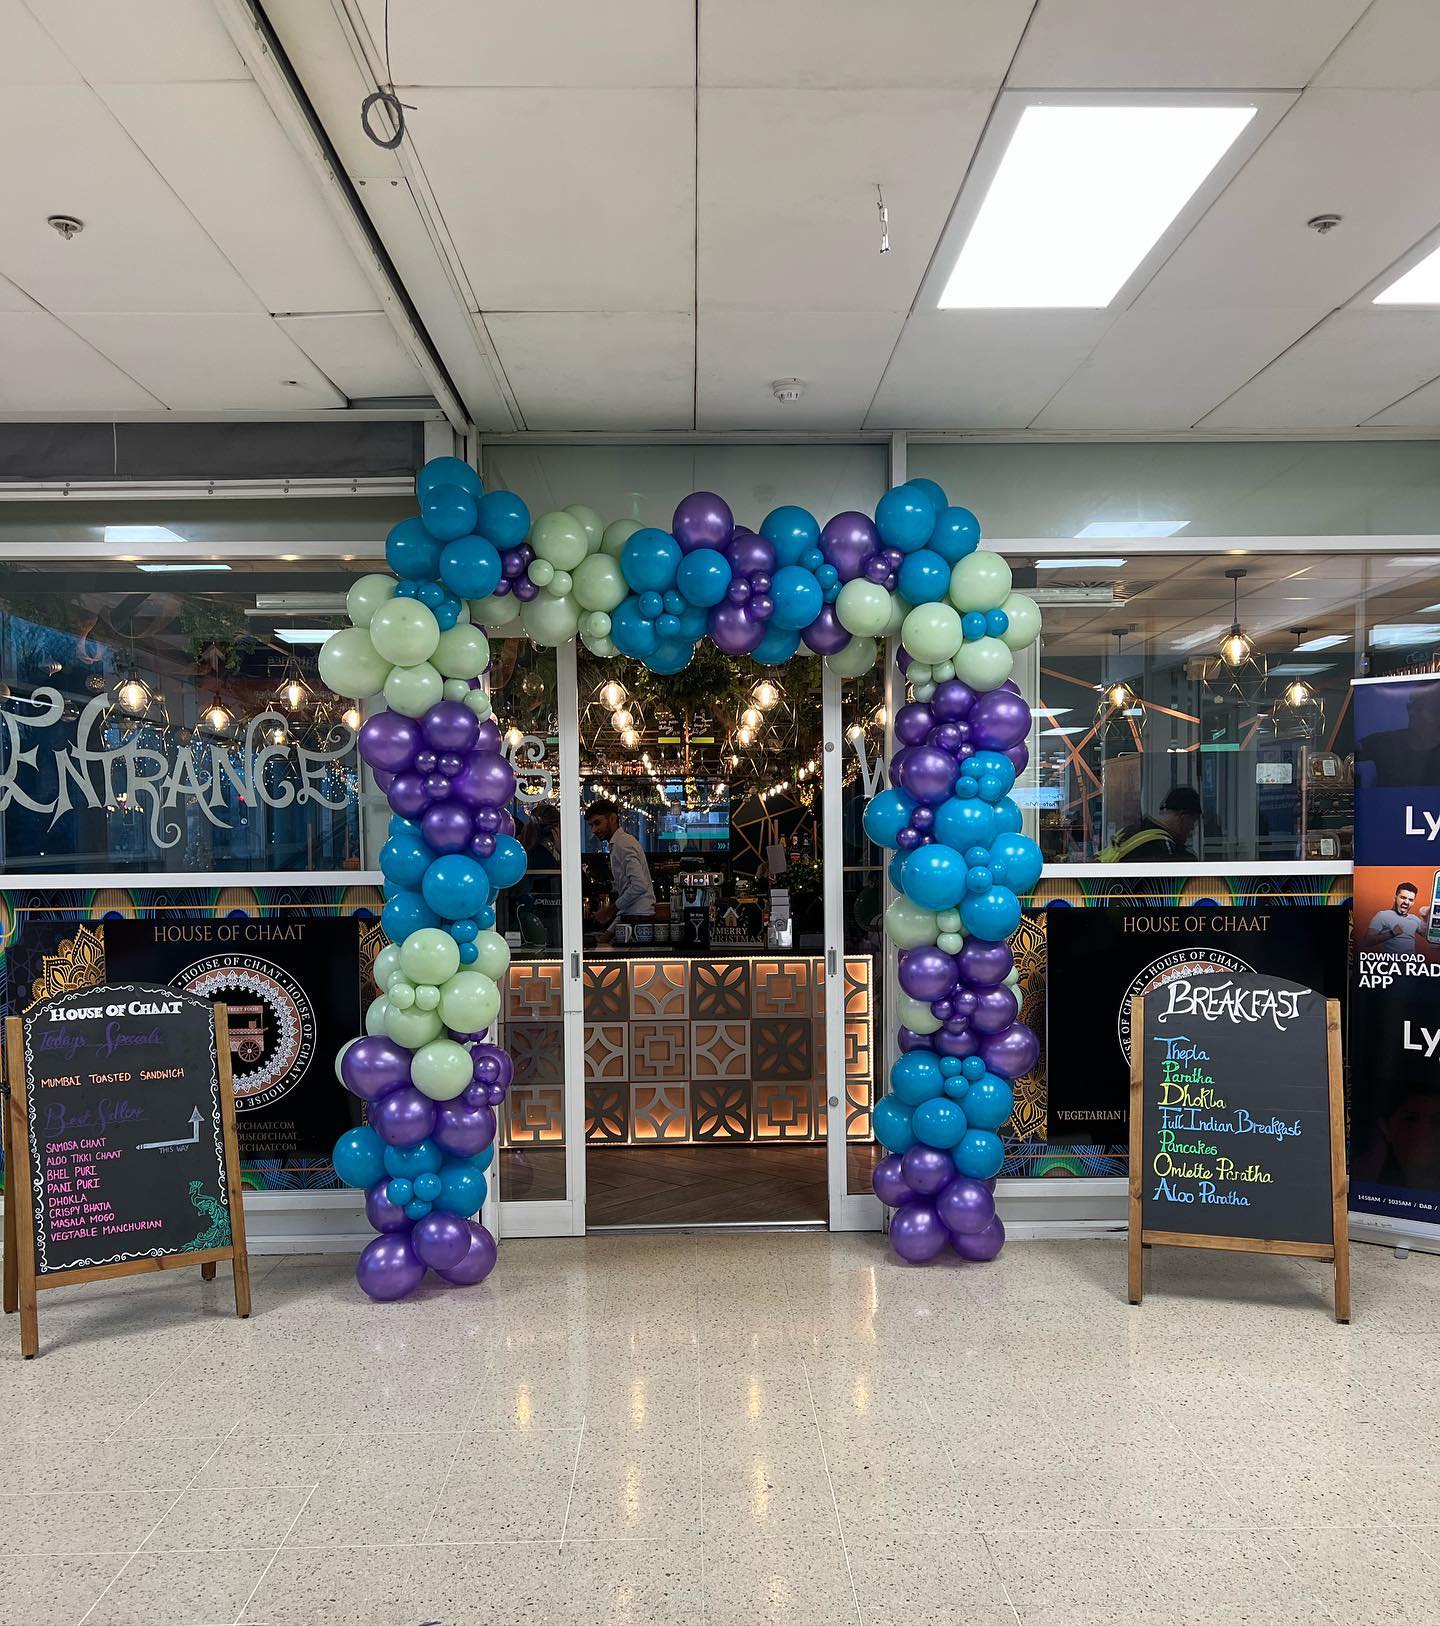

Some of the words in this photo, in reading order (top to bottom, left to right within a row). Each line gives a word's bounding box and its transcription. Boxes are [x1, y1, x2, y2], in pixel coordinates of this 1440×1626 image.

[715, 927, 748, 935] MERRY
[1123, 916, 1179, 932] HOUSE
[1184, 916, 1206, 932] OF
[1211, 915, 1270, 932] CHAAT
[154, 925, 213, 942] HOUSE
[217, 925, 240, 941] OF
[245, 924, 306, 941] CHAAT
[1148, 952, 1187, 976] HOUSE
[1190, 951, 1205, 960] OF
[1209, 952, 1247, 973] CHAAT
[1359, 952, 1425, 963] DOWNLOAD
[182, 958, 220, 982] HOUSE
[223, 957, 240, 965] OF
[244, 958, 283, 981] CHAAT
[1359, 961, 1402, 976] LYCA
[1405, 963, 1440, 979] RAD
[1358, 974, 1394, 989] APP
[286, 983, 311, 1021] HOUSE
[1158, 980, 1313, 1032] BREAKFAST
[49, 1007, 103, 1022] HOUSE
[106, 1004, 127, 1017] OF
[128, 1001, 183, 1016] CHAAT
[303, 1023, 312, 1040] OF
[1121, 1018, 1130, 1034] OF
[289, 1042, 311, 1081] CHAAT
[1153, 1036, 1210, 1069] Thepla
[41, 1075, 82, 1089] MUMBAI
[88, 1072, 131, 1084] TOASTED
[140, 1068, 185, 1081] SANDWICH
[1161, 1060, 1215, 1084] Paratha
[248, 1083, 286, 1107] HOUSE
[1057, 1110, 1121, 1120] VEGETARIAN
[1158, 1106, 1184, 1130] Full
[1183, 1107, 1235, 1133] Indian
[1233, 1109, 1302, 1142] Breakfast
[46, 1140, 79, 1153] SAMOSA
[80, 1137, 107, 1149] CHAAT
[158, 1146, 173, 1155] THIS
[175, 1144, 191, 1153] WAY
[1157, 1129, 1218, 1156] Pancakes
[46, 1156, 67, 1167] ALOO
[70, 1153, 92, 1163] TIKKI
[95, 1149, 123, 1160] CHAAT
[1153, 1152, 1213, 1180] Omlette
[47, 1168, 70, 1181] BHEL
[74, 1165, 98, 1177] PURI
[47, 1181, 73, 1194] PANI
[76, 1178, 100, 1190] PURI
[1152, 1177, 1195, 1204] Aloo
[1199, 1181, 1251, 1206] Paratha
[49, 1193, 87, 1208] DHOKLA
[1358, 1194, 1381, 1203] 1458AM
[49, 1206, 81, 1219] CRISPY
[50, 1216, 86, 1229] MASALA
[89, 1212, 115, 1224] MOGO
[51, 1227, 98, 1242] VEGTABLE
[102, 1219, 162, 1236] MANCHURIAN
